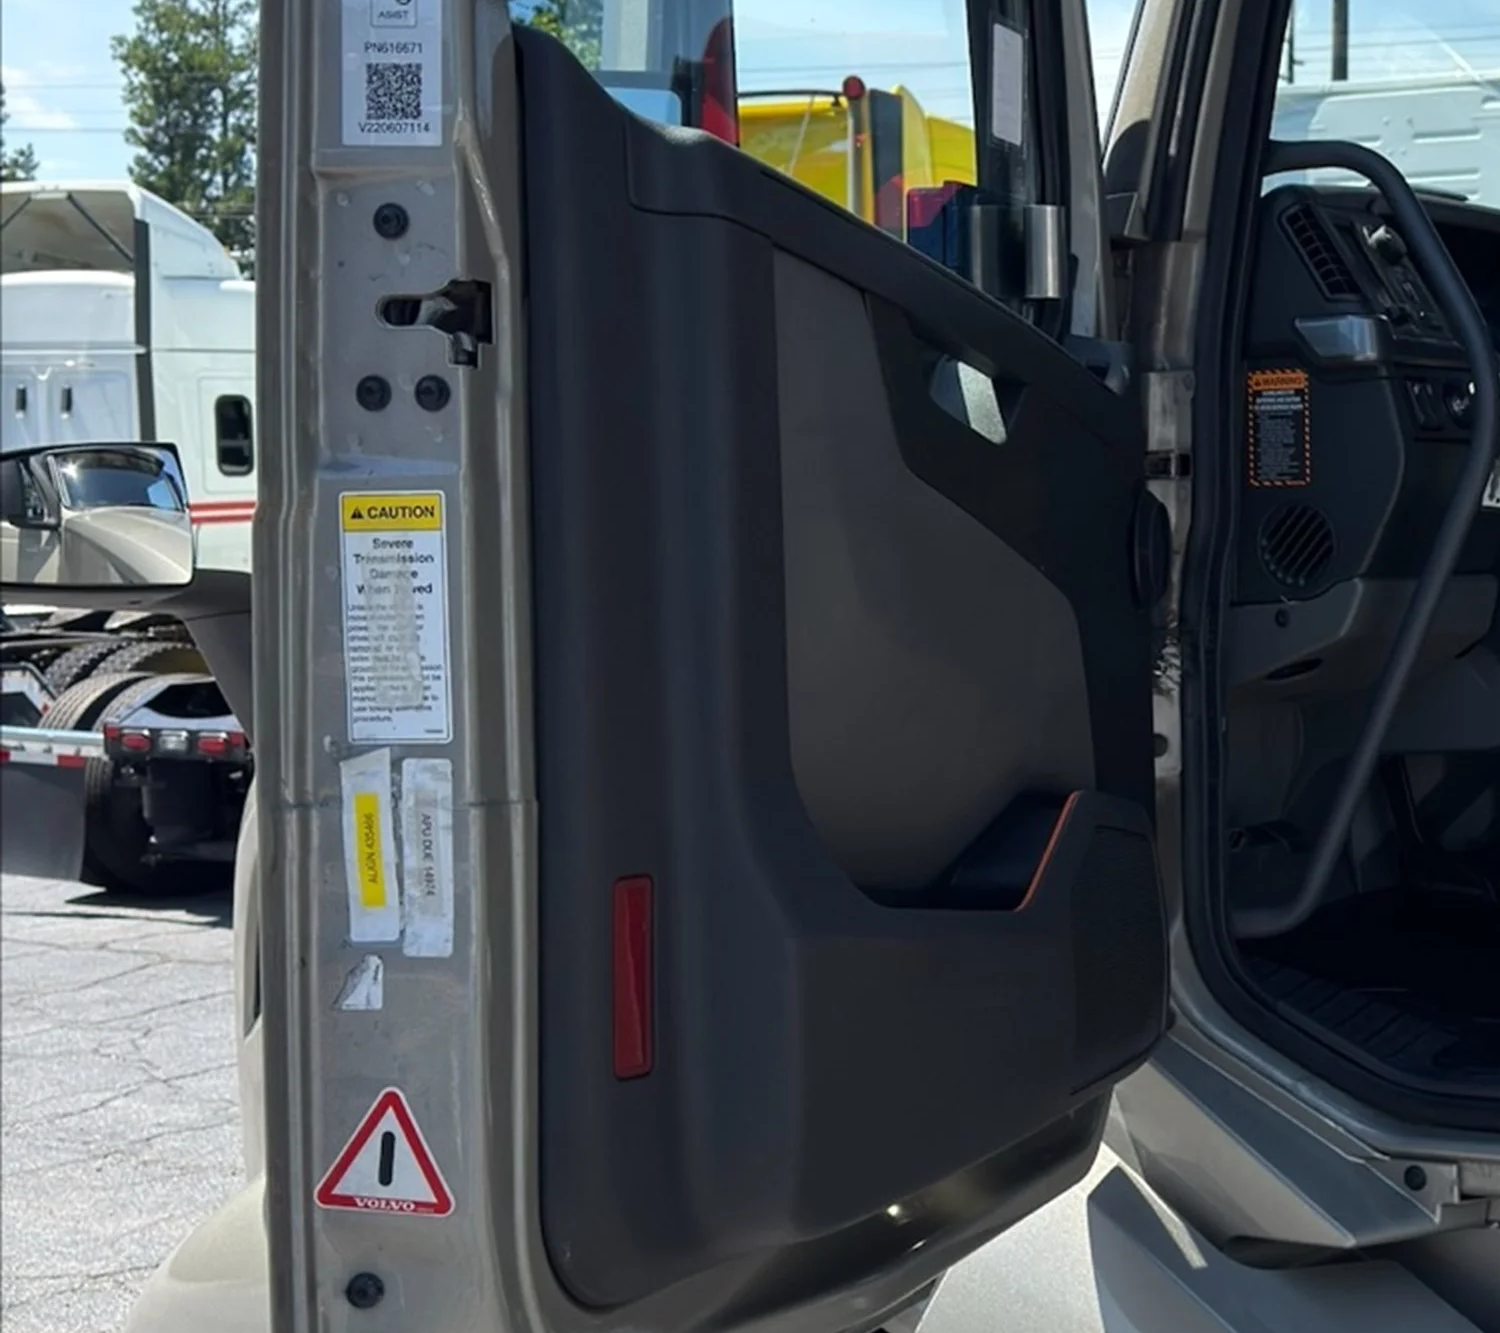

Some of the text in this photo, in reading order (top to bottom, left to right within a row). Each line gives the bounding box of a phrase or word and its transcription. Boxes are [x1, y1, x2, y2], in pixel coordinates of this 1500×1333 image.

[367, 505, 435, 519] CAUTION
[372, 537, 414, 549] Severe
[353, 1197, 416, 1212] VOLVO
